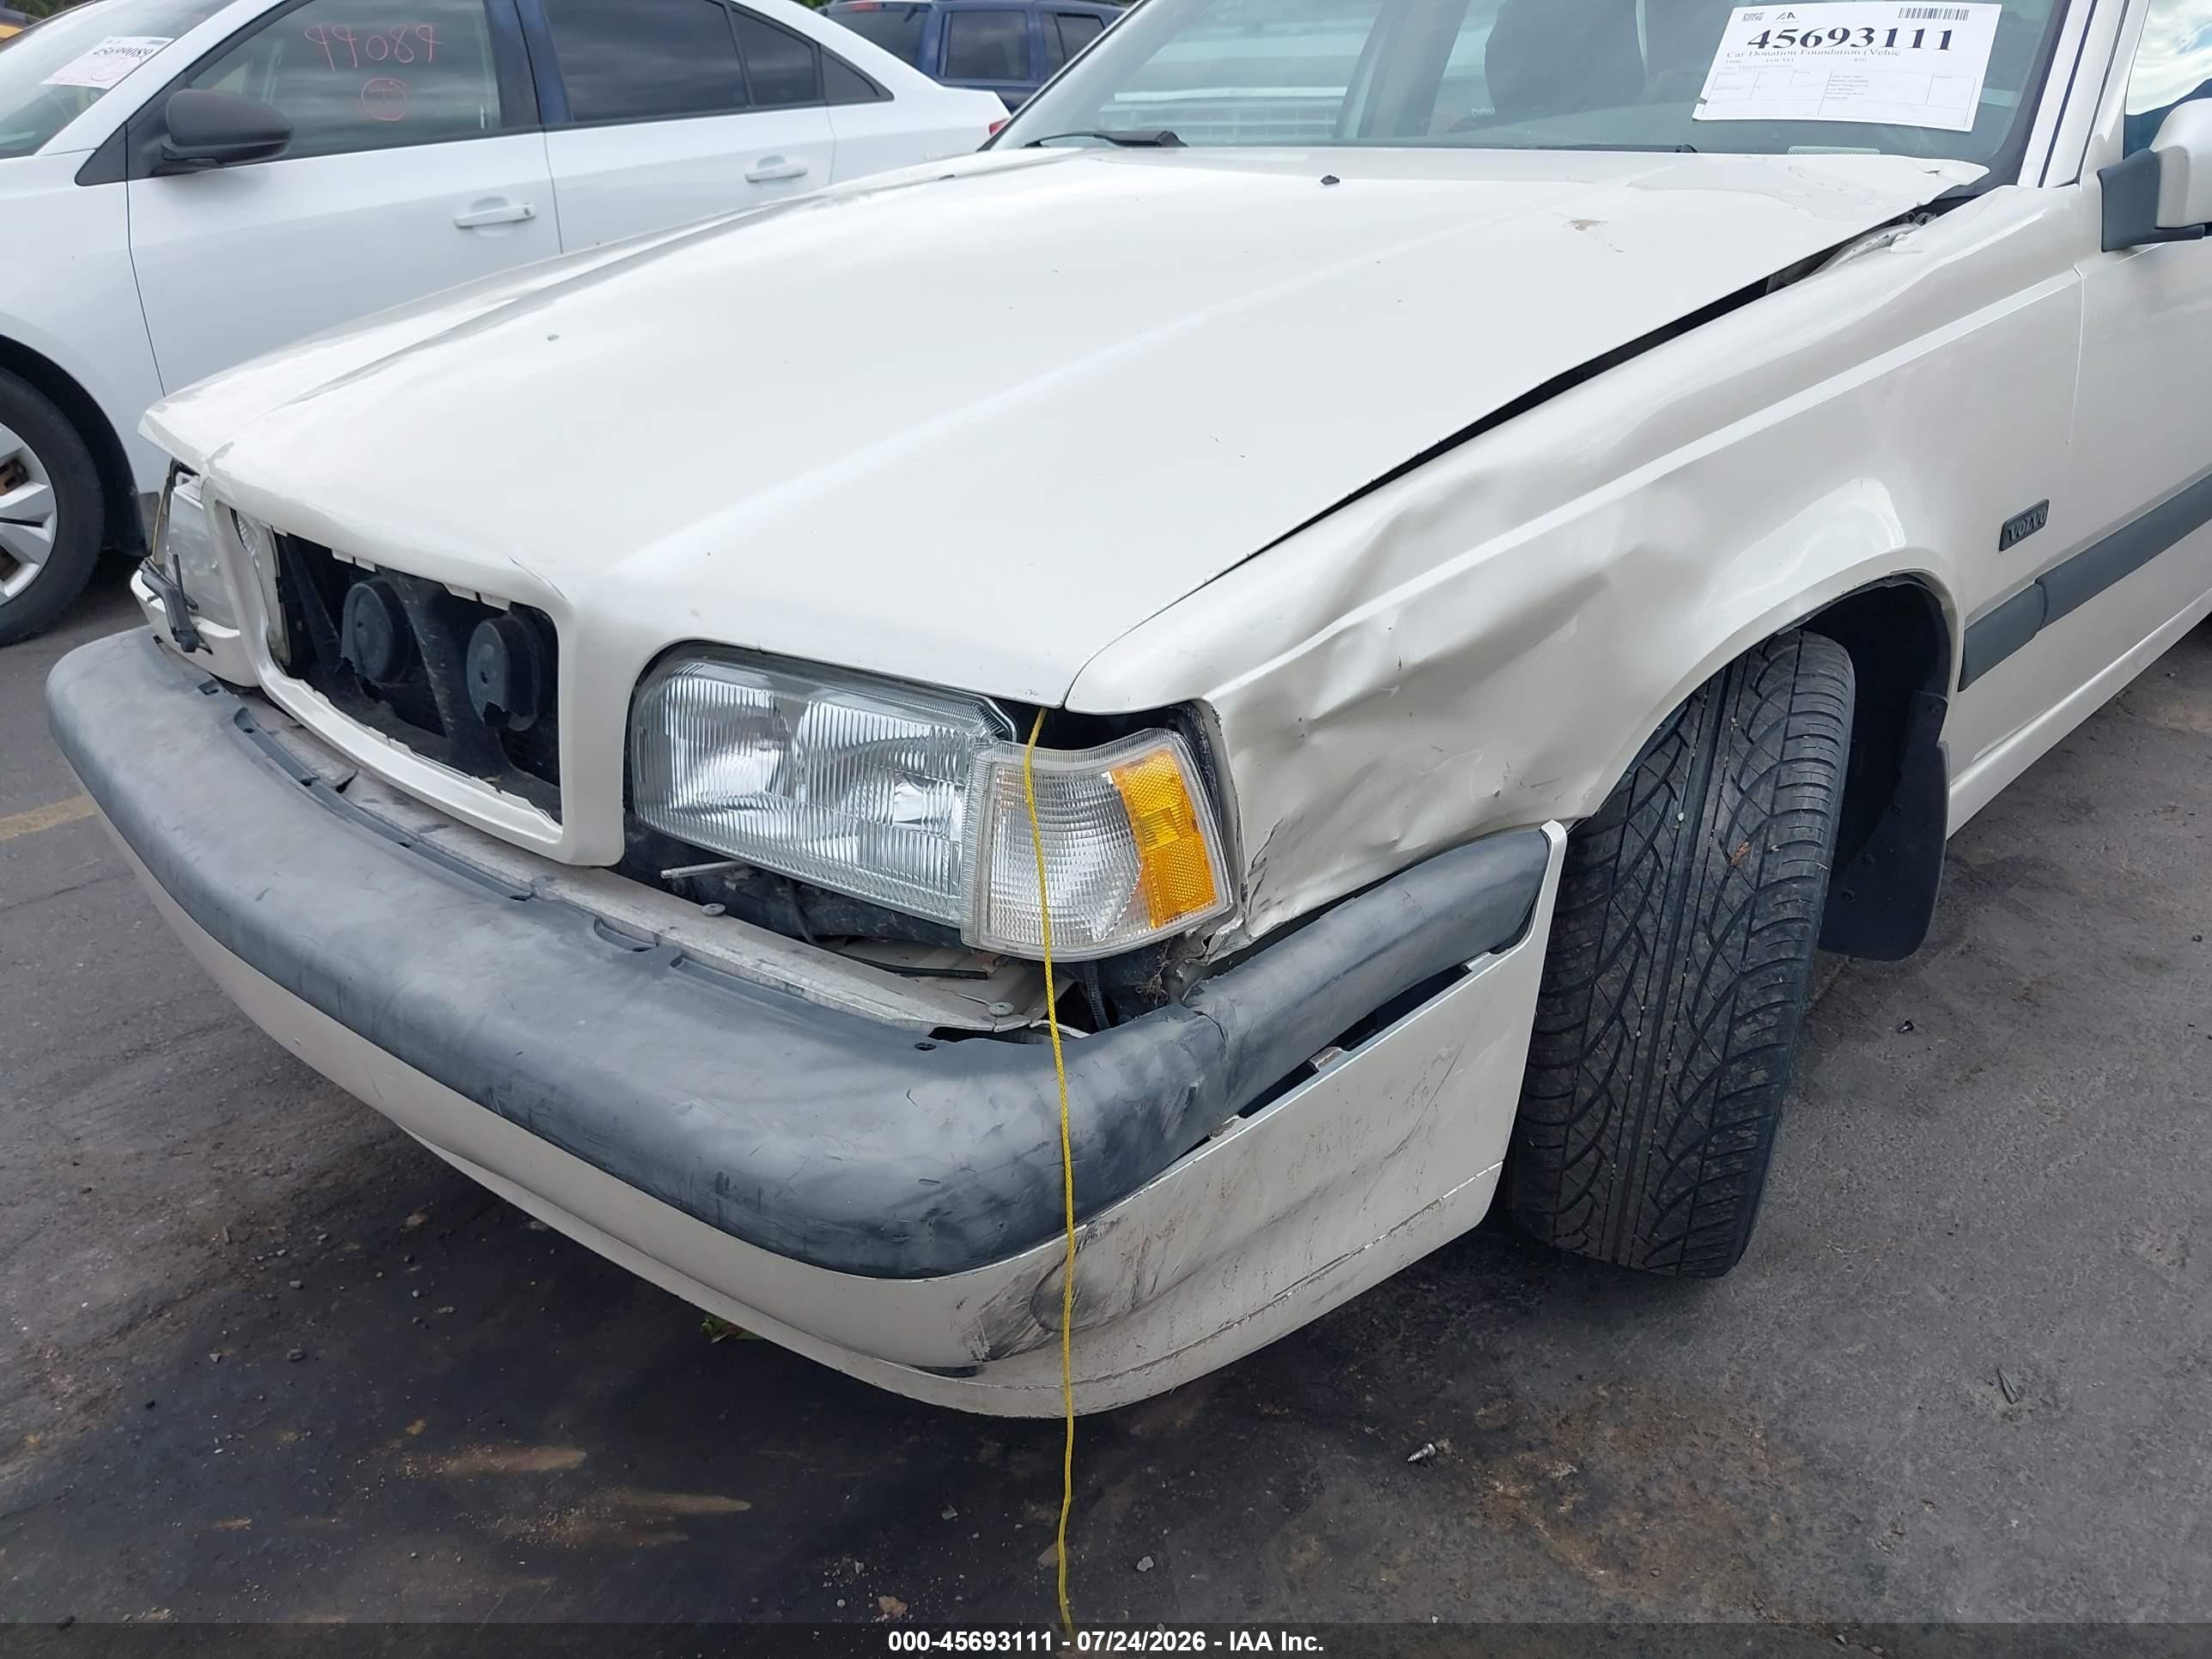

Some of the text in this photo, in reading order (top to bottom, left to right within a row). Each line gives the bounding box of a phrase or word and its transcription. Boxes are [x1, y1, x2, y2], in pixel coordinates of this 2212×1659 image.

[304, 24, 442, 72] 99089
[1747, 27, 1954, 51] 45693111
[2008, 509, 2047, 541] VOLVO
